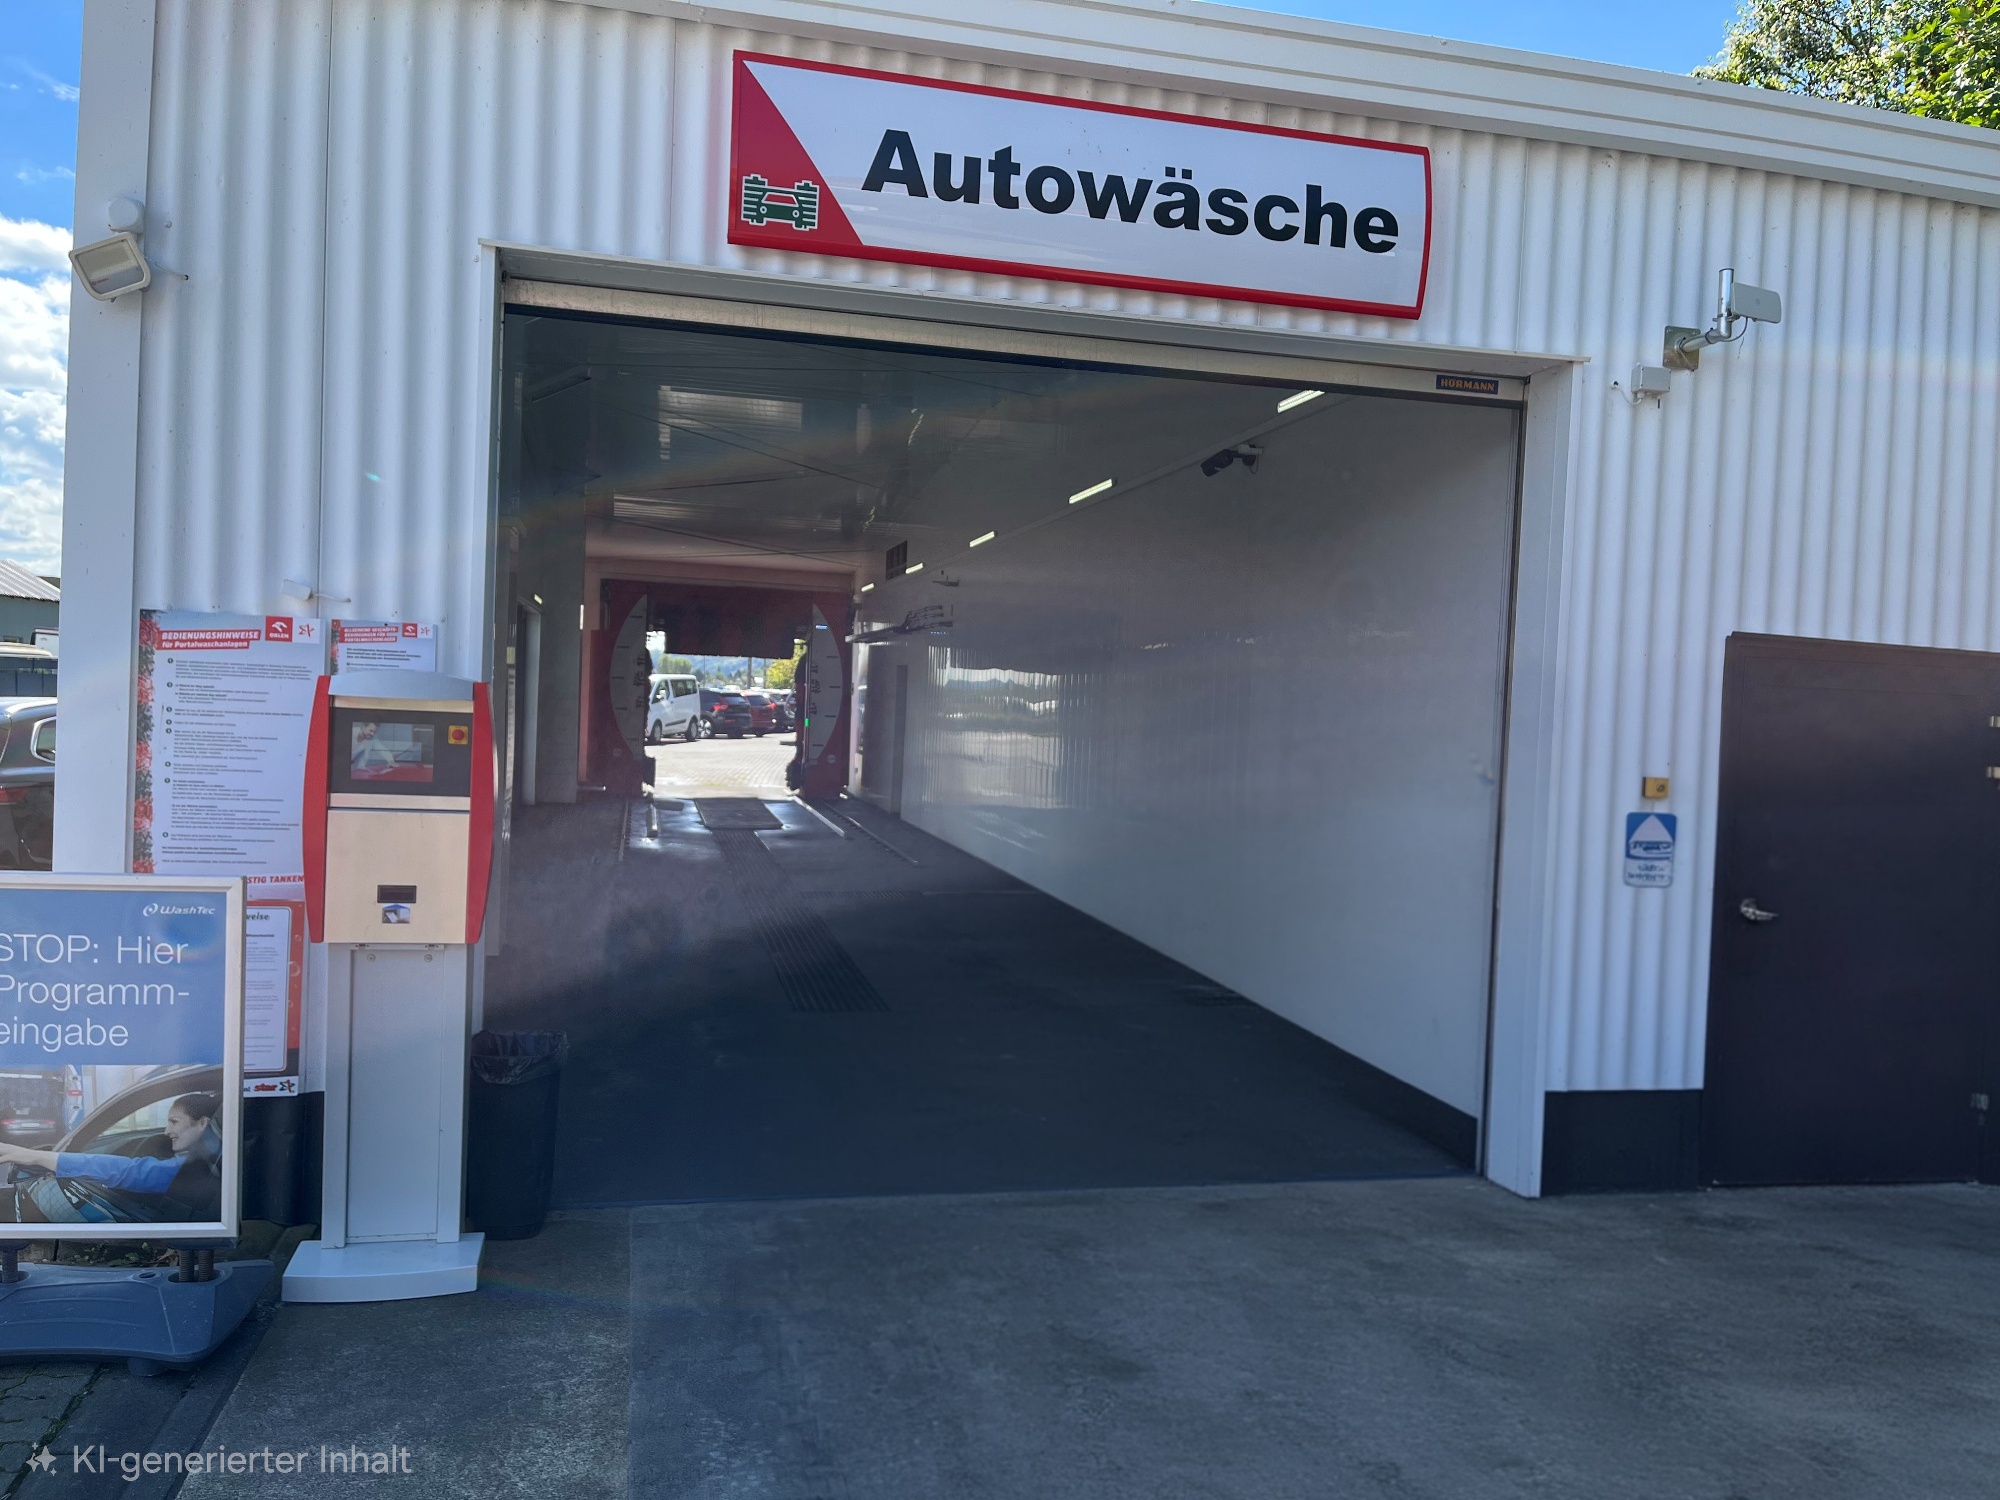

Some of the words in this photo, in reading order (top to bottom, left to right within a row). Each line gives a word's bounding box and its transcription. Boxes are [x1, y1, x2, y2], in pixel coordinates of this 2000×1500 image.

[861, 128, 1399, 254] Autowäsche
[161, 630, 259, 640] BEDIENUNGSHINWEISE
[162, 640, 173, 648] für
[174, 640, 248, 649] Portalwaschanlagen
[160, 905, 216, 915] WashTec
[0, 933, 99, 964] STOP:
[117, 935, 189, 965] Hier
[0, 974, 190, 1011] Programm-
